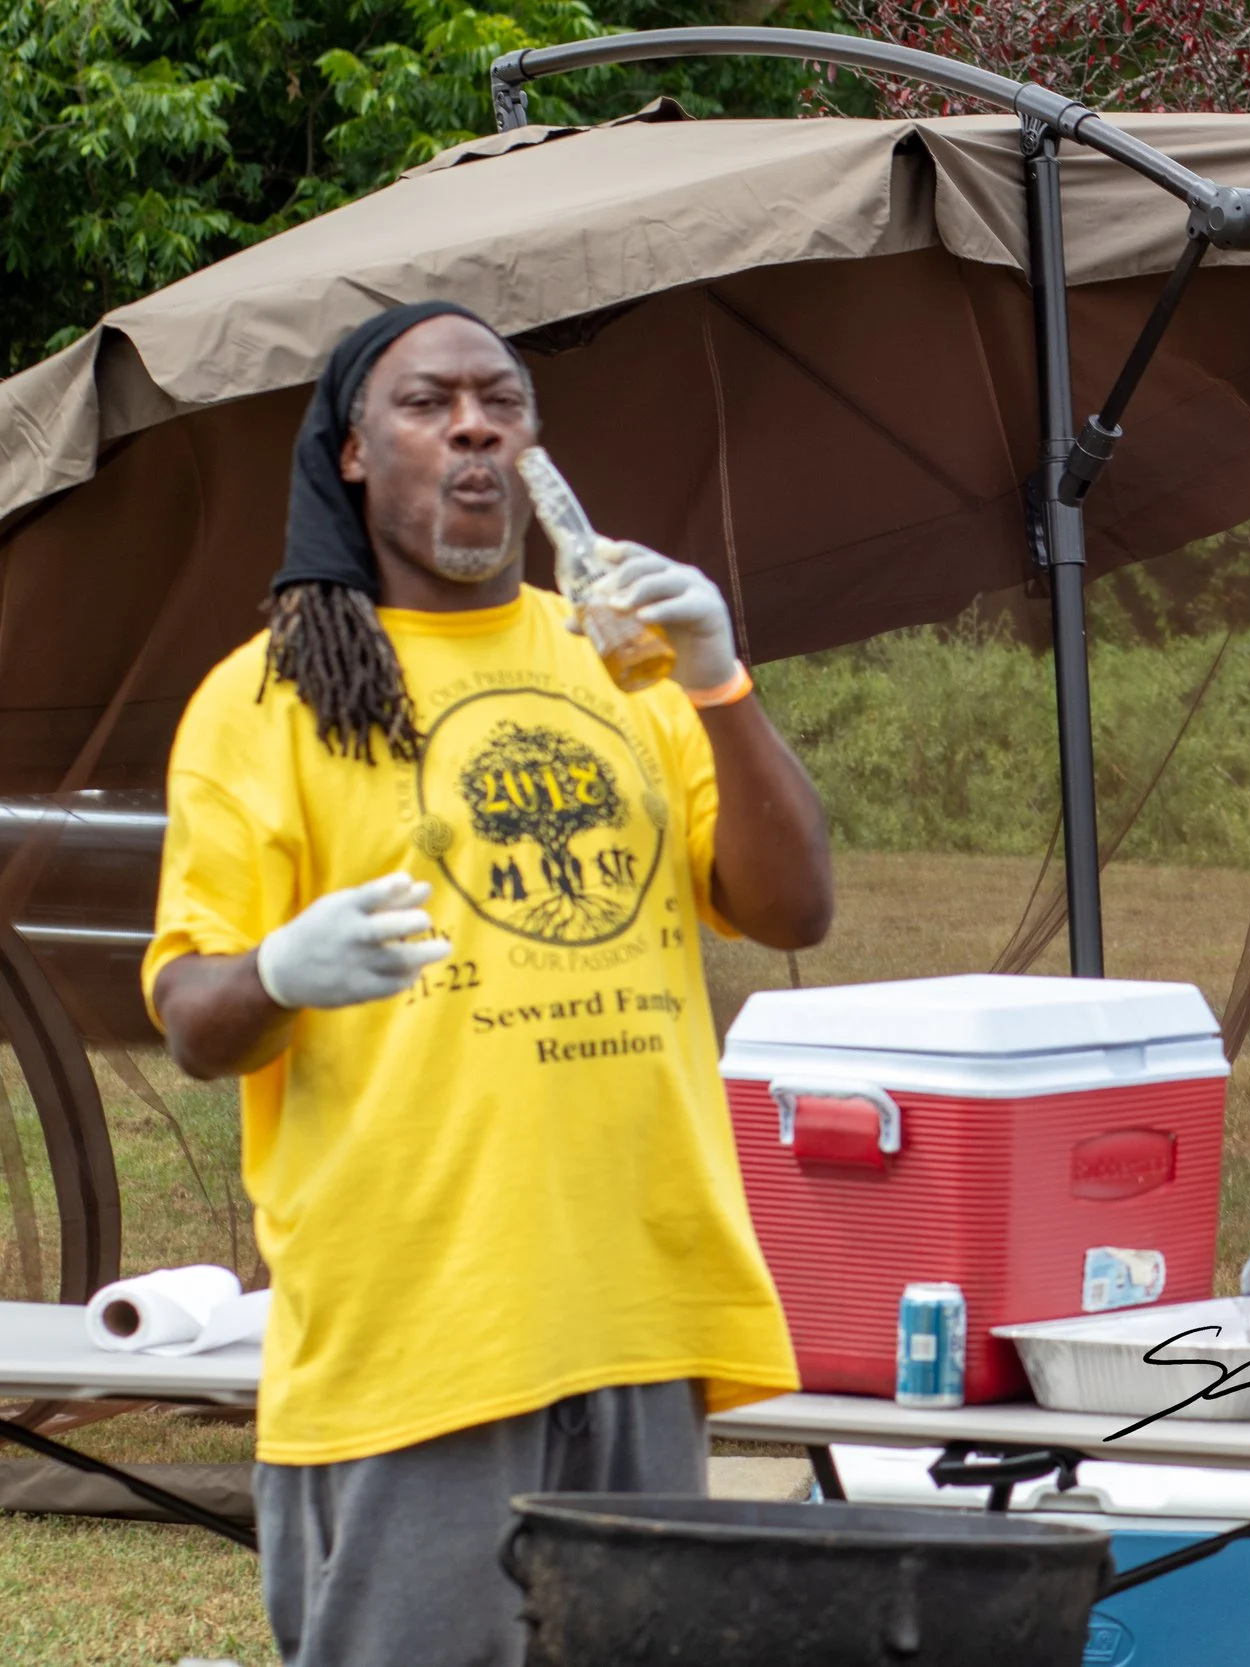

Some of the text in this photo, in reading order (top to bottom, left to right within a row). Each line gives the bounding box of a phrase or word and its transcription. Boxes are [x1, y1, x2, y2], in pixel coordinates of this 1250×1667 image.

[430, 677, 473, 707] OUR
[483, 761, 607, 814] 2018
[508, 944, 563, 971] OUR
[472, 989, 605, 1035] Seward
[536, 1029, 665, 1065] Reunion
